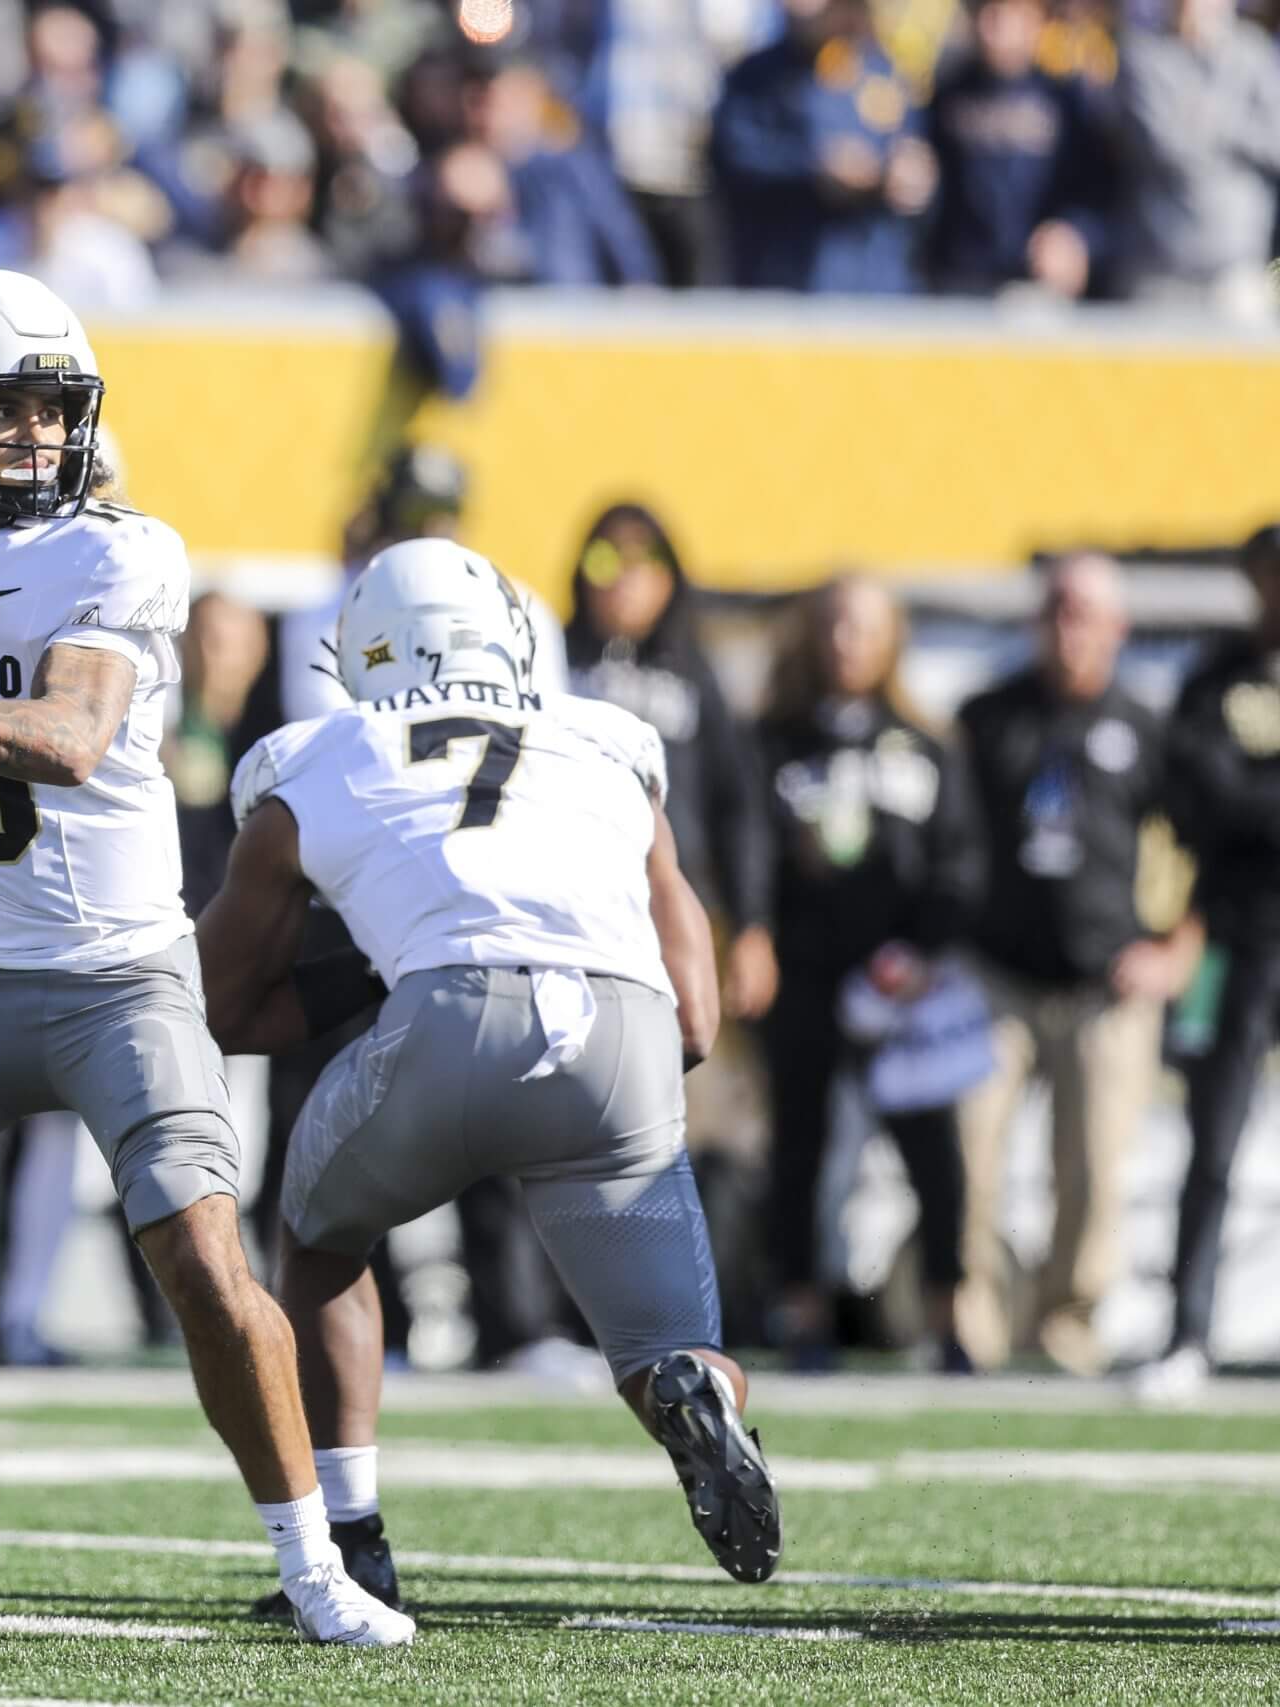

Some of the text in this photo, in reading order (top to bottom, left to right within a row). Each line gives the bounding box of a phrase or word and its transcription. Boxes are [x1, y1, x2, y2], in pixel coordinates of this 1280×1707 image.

[39, 354, 70, 369] BUFFS
[427, 652, 442, 682] 7
[402, 715, 528, 832] 7
